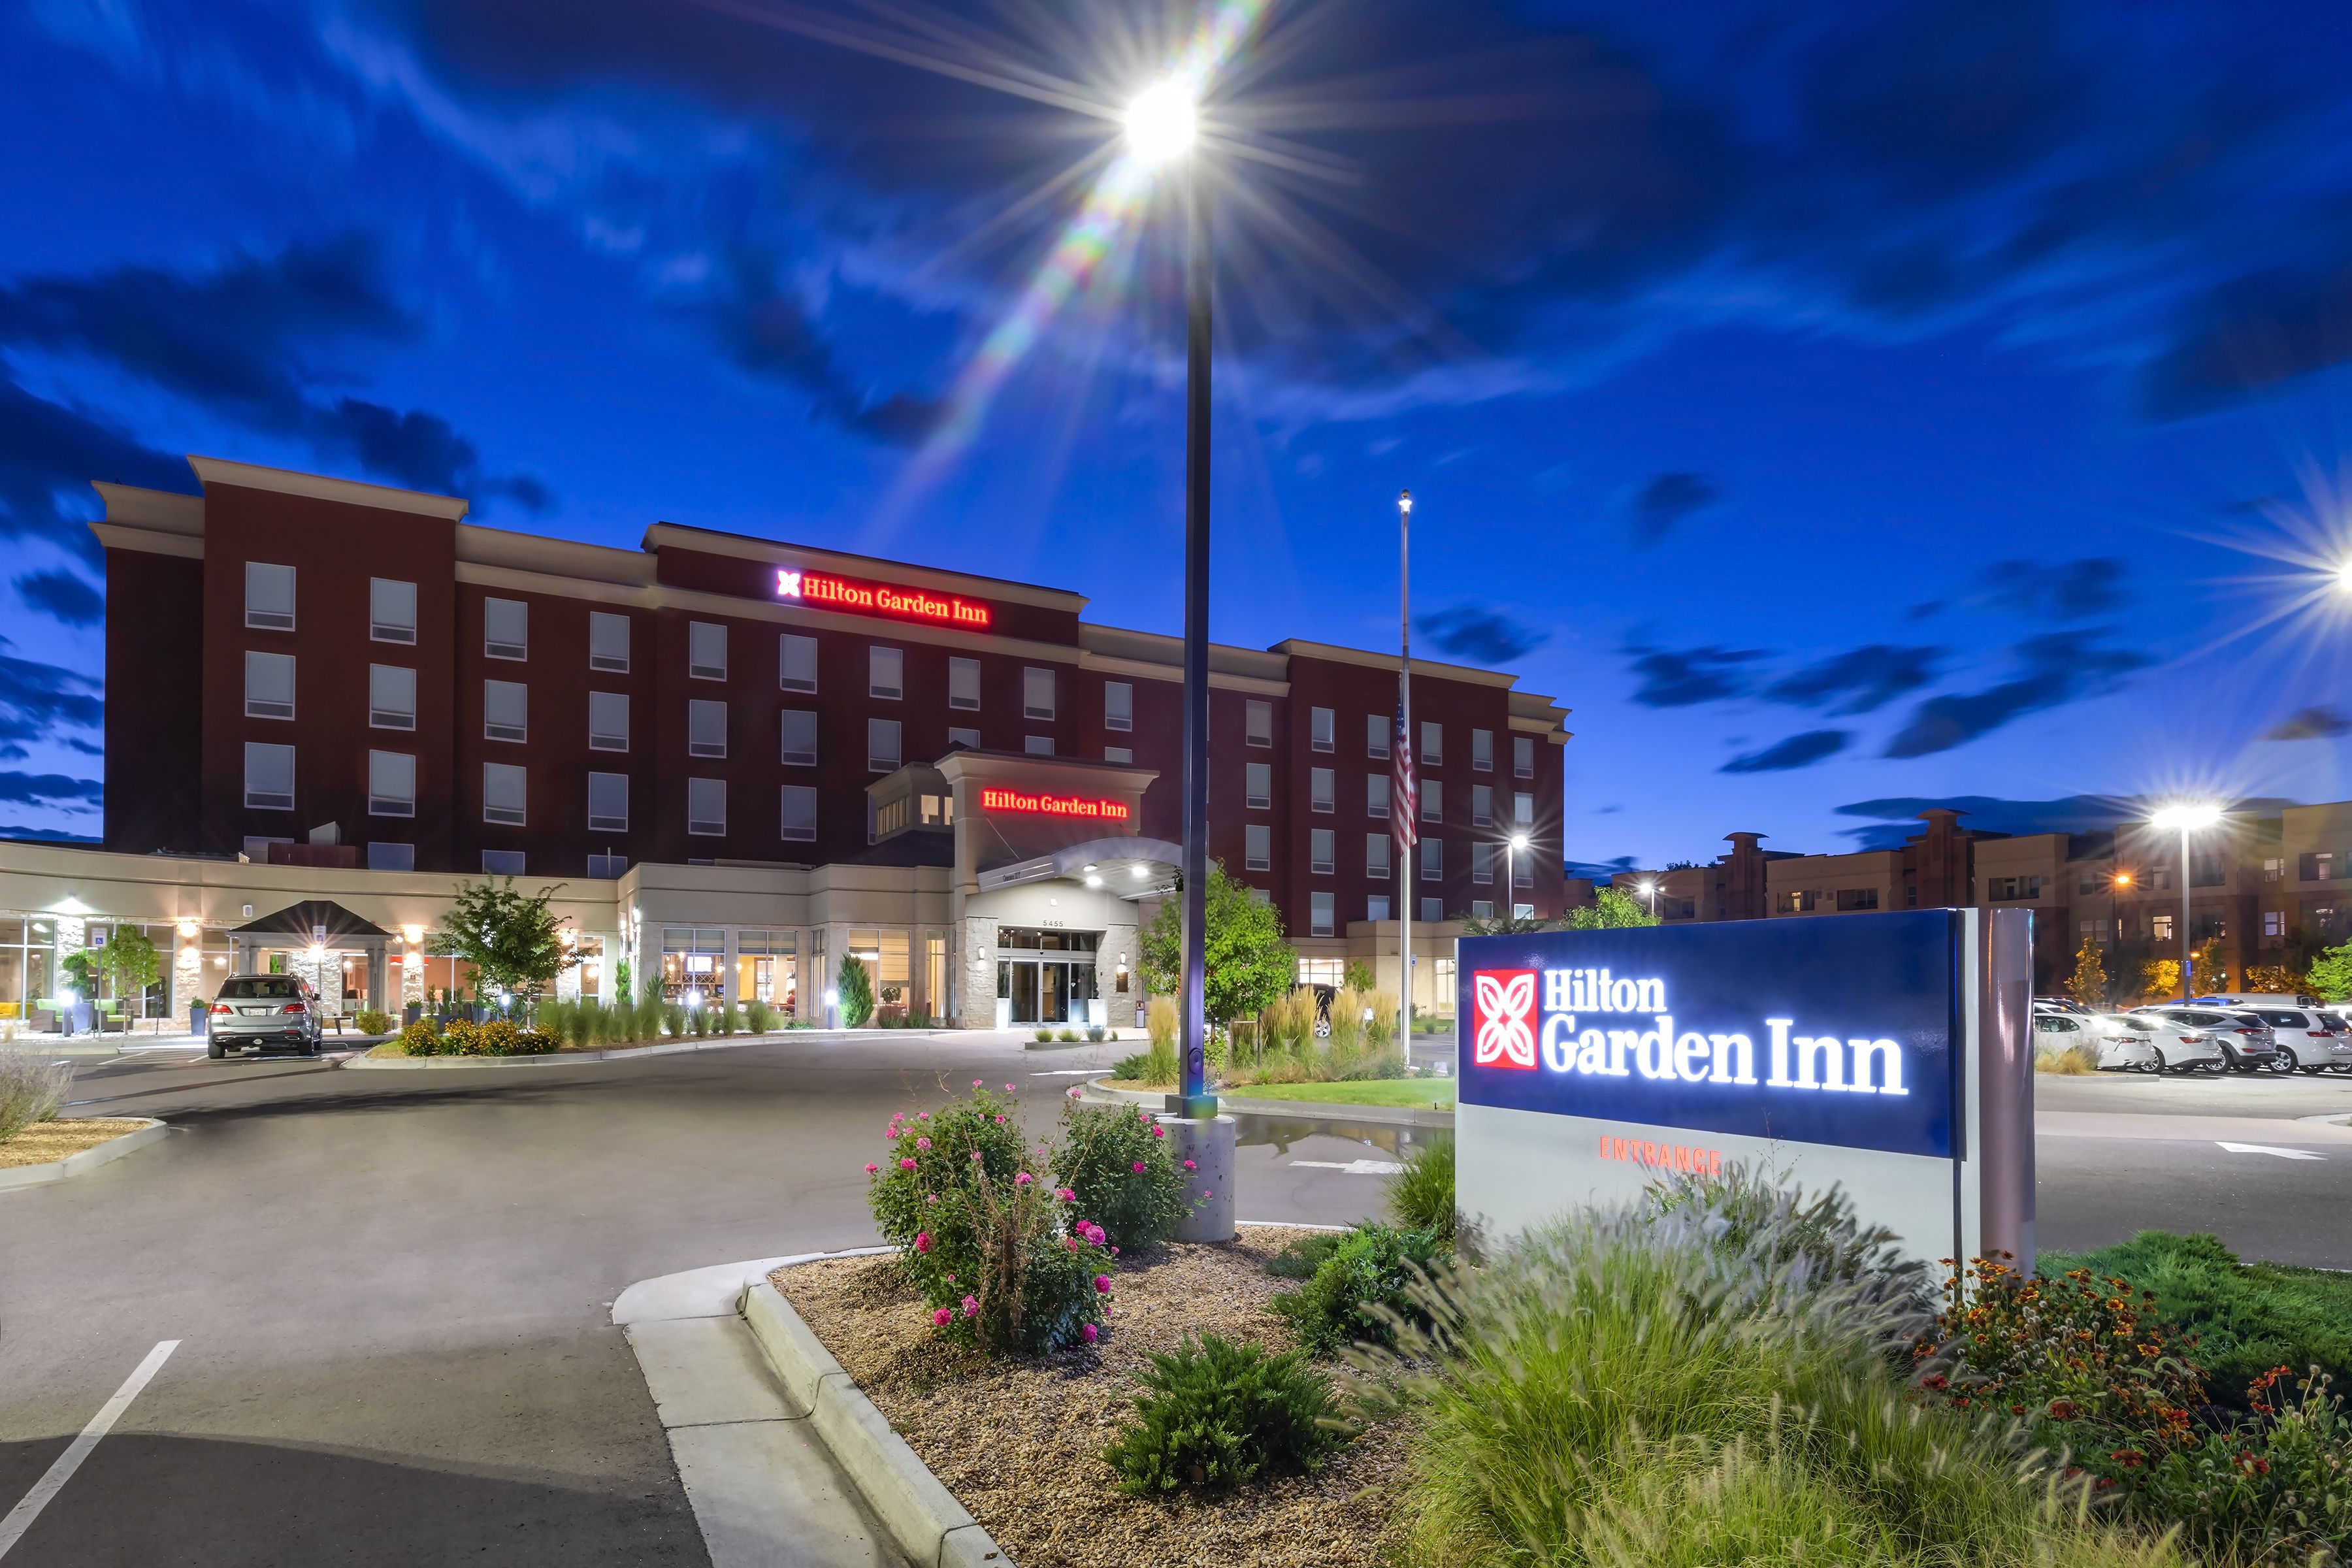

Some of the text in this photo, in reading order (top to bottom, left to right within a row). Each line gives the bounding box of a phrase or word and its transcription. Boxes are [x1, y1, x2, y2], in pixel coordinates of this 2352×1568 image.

[803, 578, 988, 623] Hilton Garden Inn
[983, 791, 1128, 818] Hilton Garden Inn
[1544, 970, 1667, 1012] Hilton
[1542, 1013, 1909, 1095] Garden Inn
[1599, 1135, 1722, 1175] ENTRANCE
